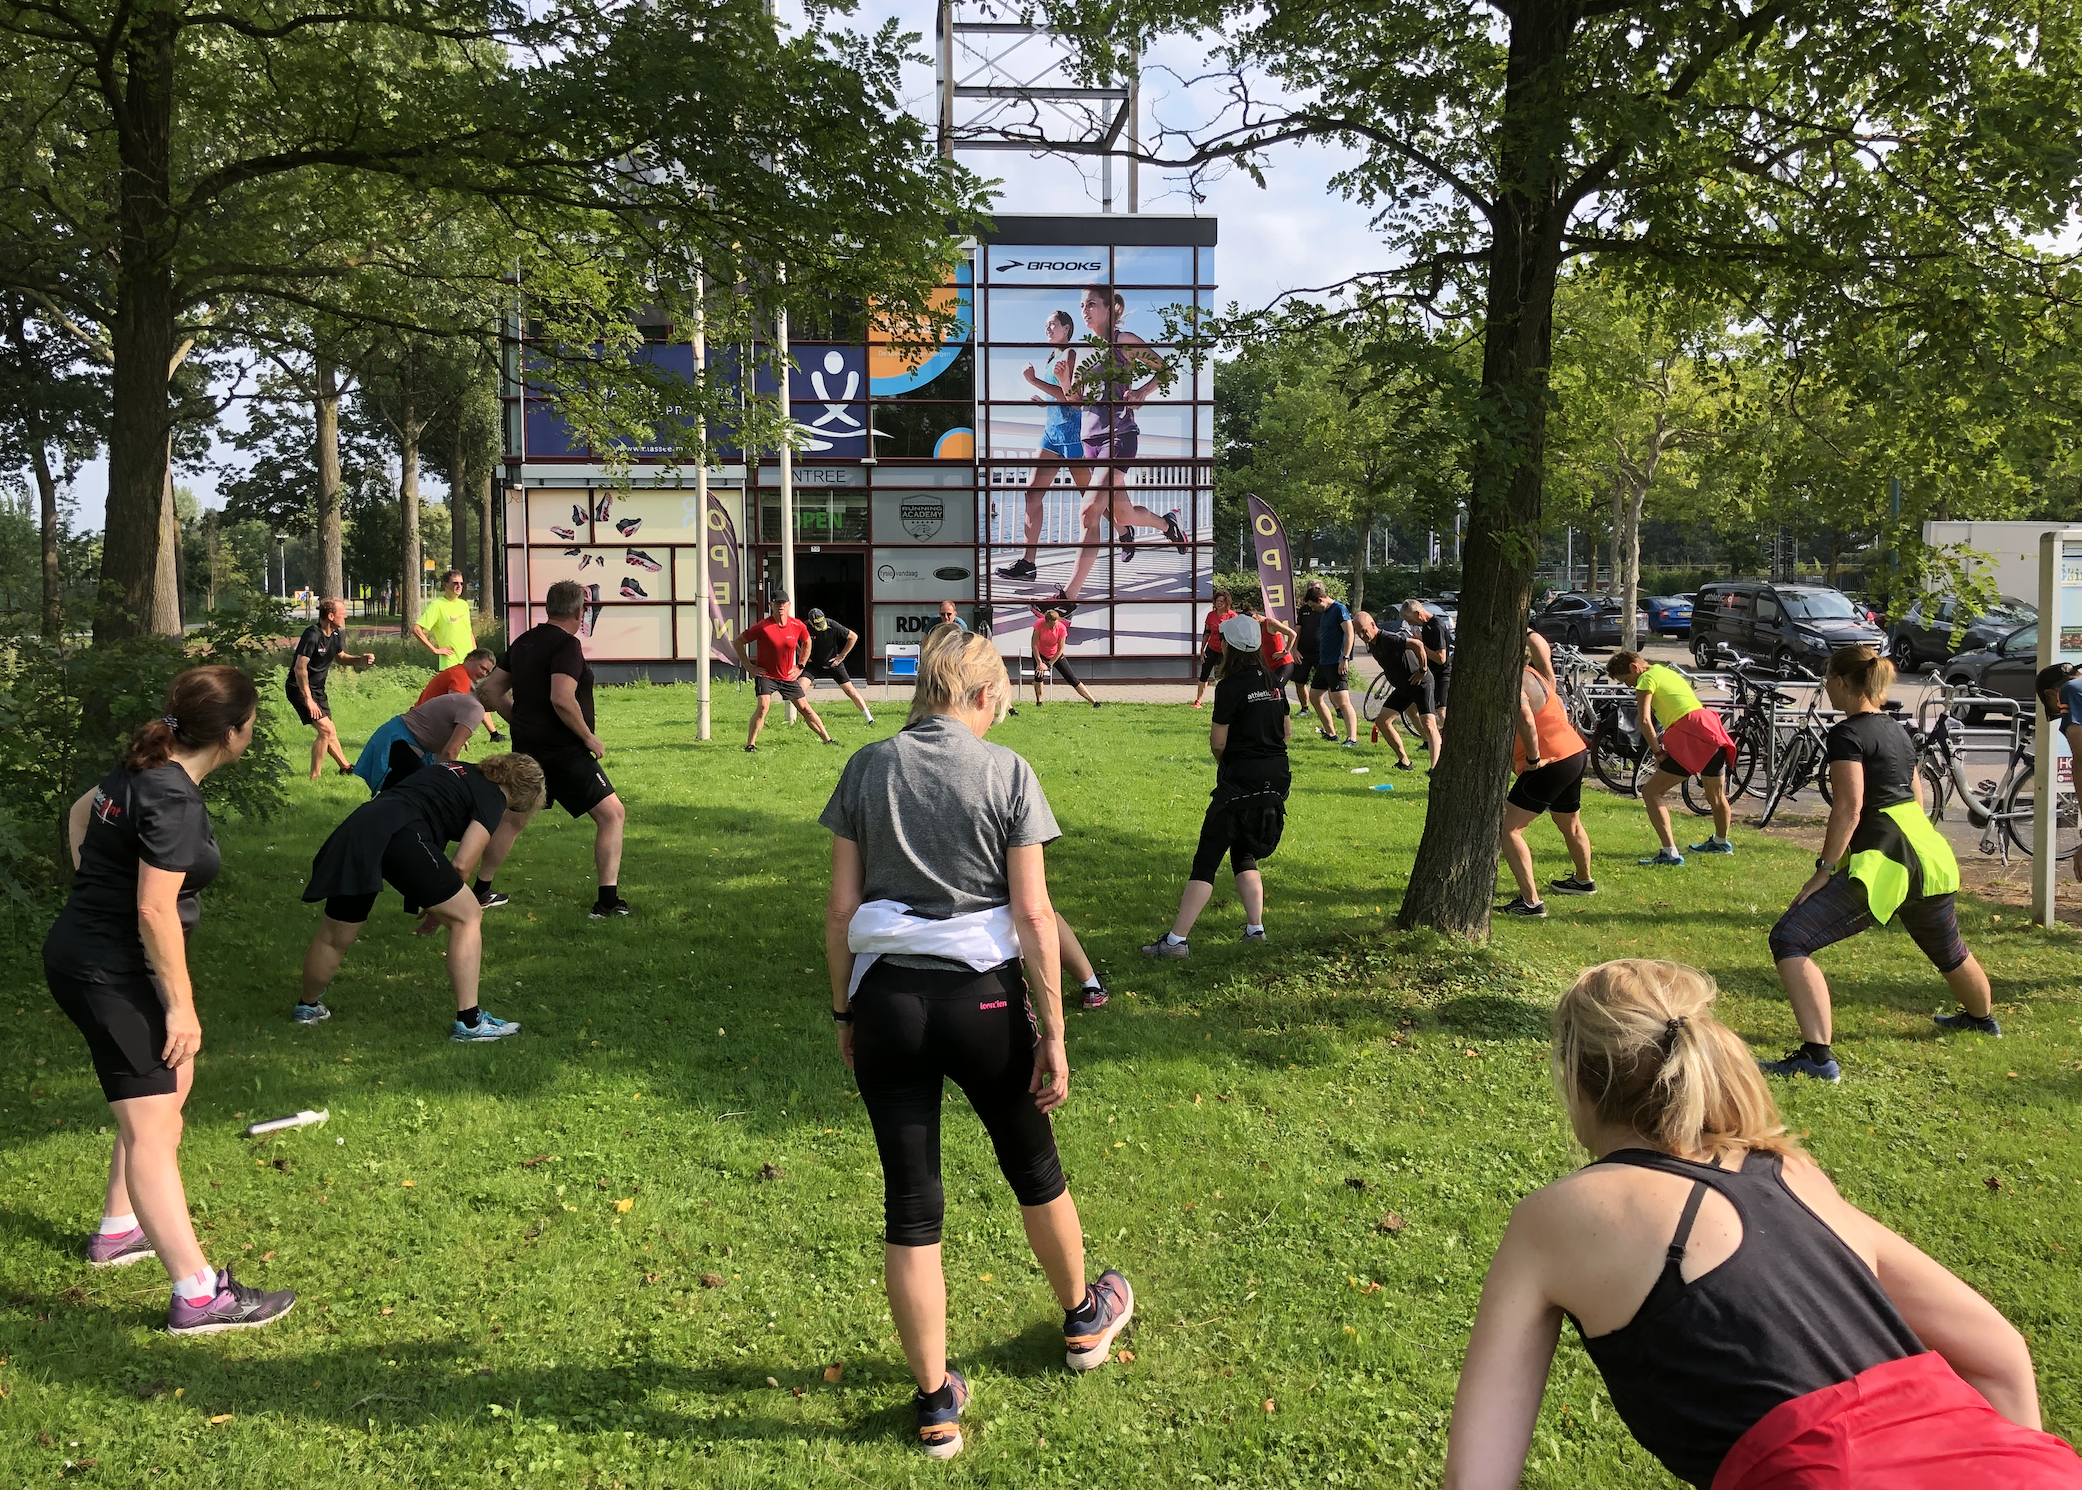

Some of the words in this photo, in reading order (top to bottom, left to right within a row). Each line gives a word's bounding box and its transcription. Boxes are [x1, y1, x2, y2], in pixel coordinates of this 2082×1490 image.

[1027, 261, 1102, 271] BROOKS
[791, 469, 847, 483] NTREE
[791, 511, 843, 529] OPEN
